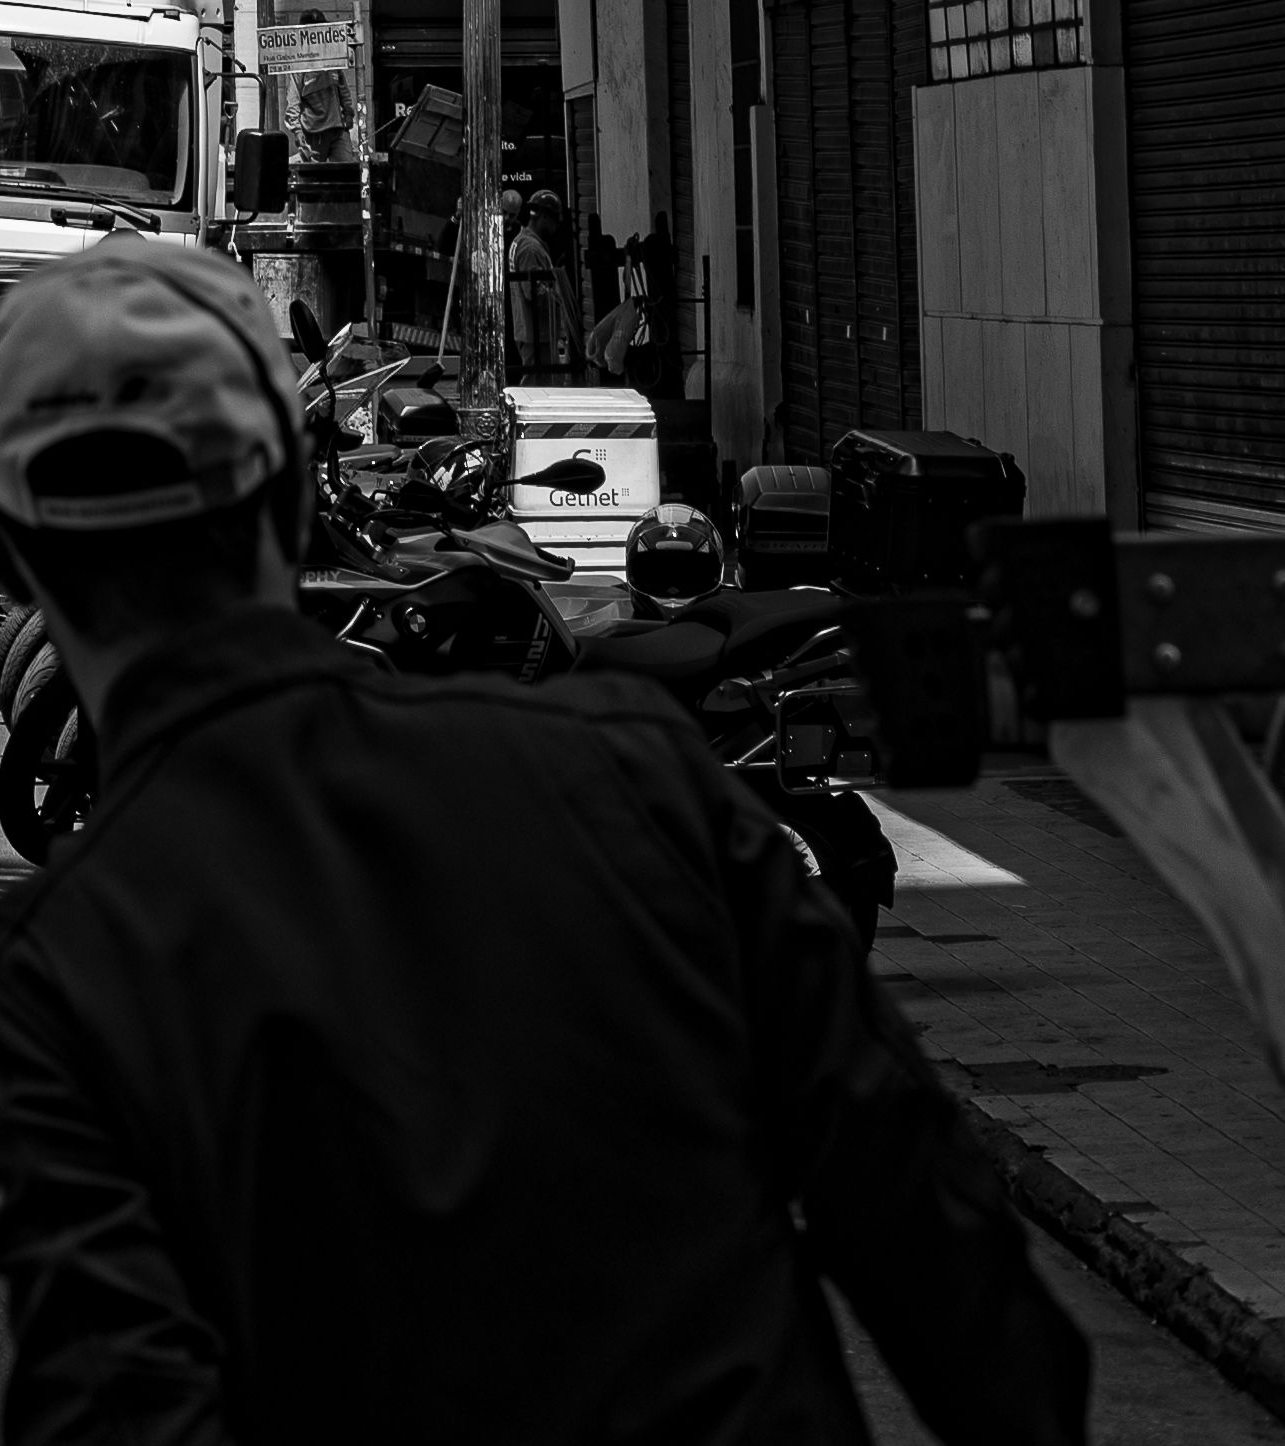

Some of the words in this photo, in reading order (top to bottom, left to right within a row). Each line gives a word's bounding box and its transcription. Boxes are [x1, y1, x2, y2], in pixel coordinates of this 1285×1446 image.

[259, 32, 297, 49] Gabus
[299, 27, 346, 46] Mendes
[511, 170, 533, 182] vida
